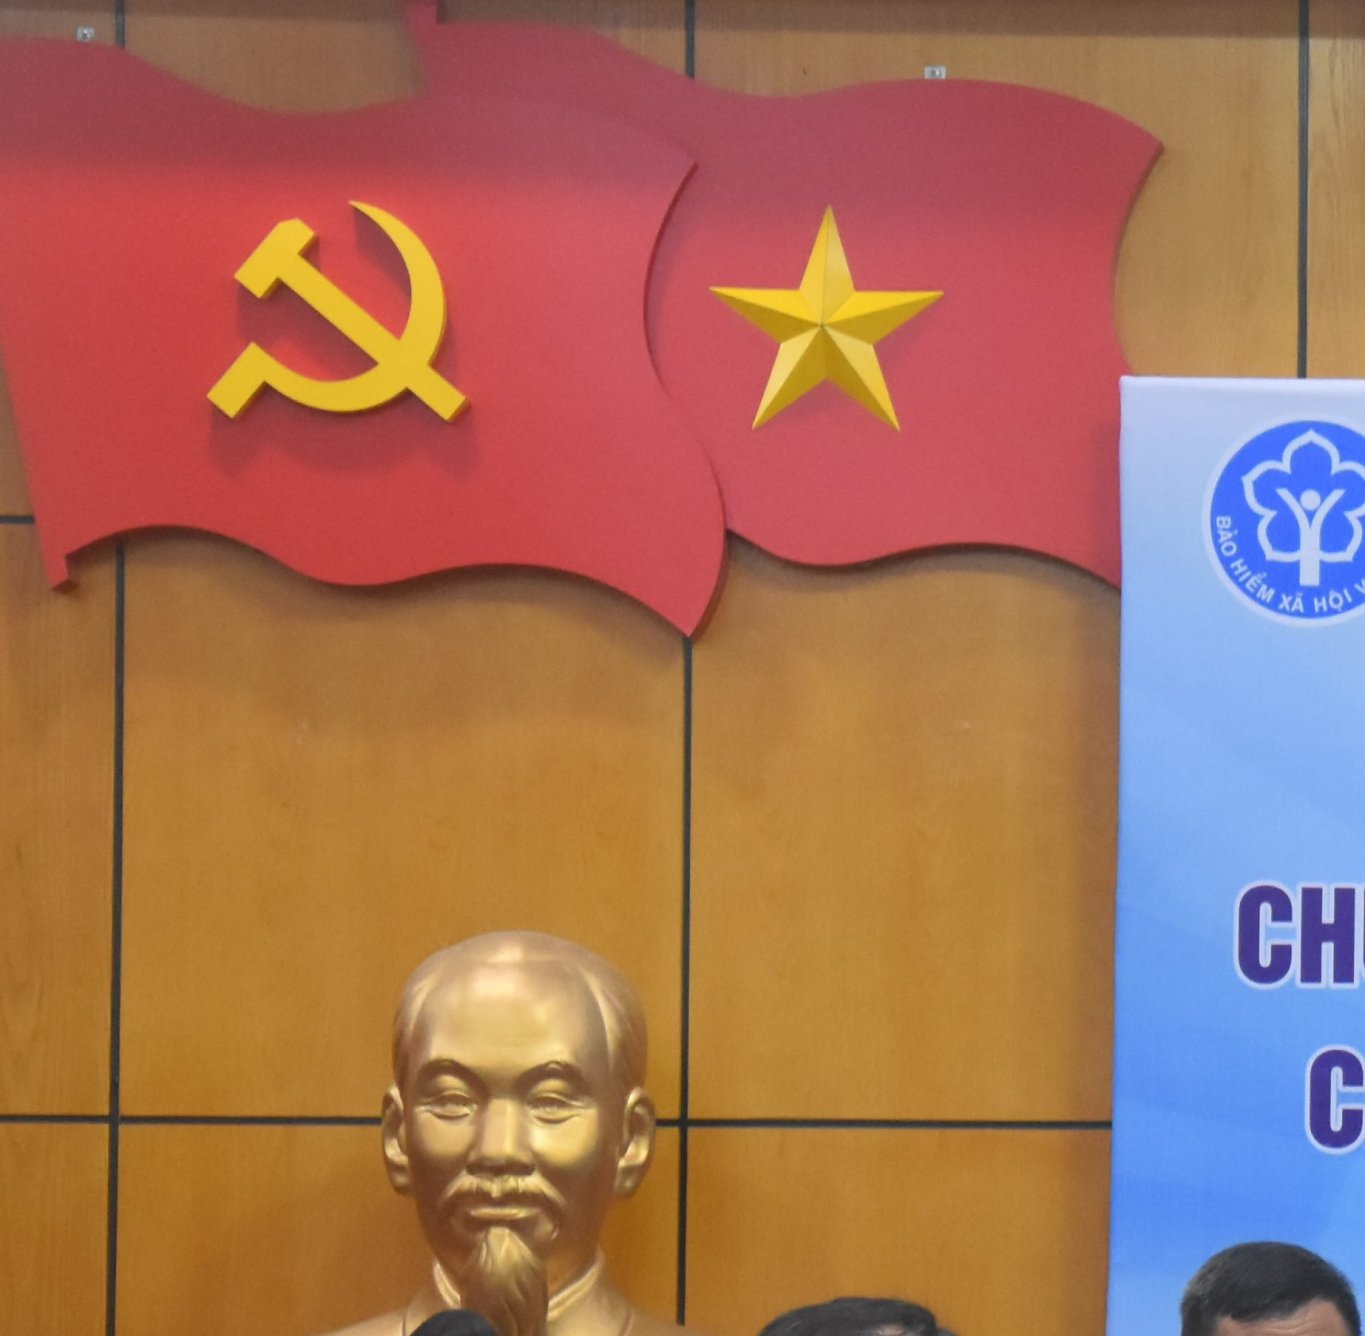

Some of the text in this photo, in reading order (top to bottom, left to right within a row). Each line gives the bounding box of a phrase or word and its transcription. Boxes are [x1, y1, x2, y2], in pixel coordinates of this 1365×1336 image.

[1216, 515, 1238, 557] BẢO
[1230, 558, 1275, 604] HIỂM
[1278, 592, 1305, 613] XÃ
[1313, 588, 1352, 613] HỘI
